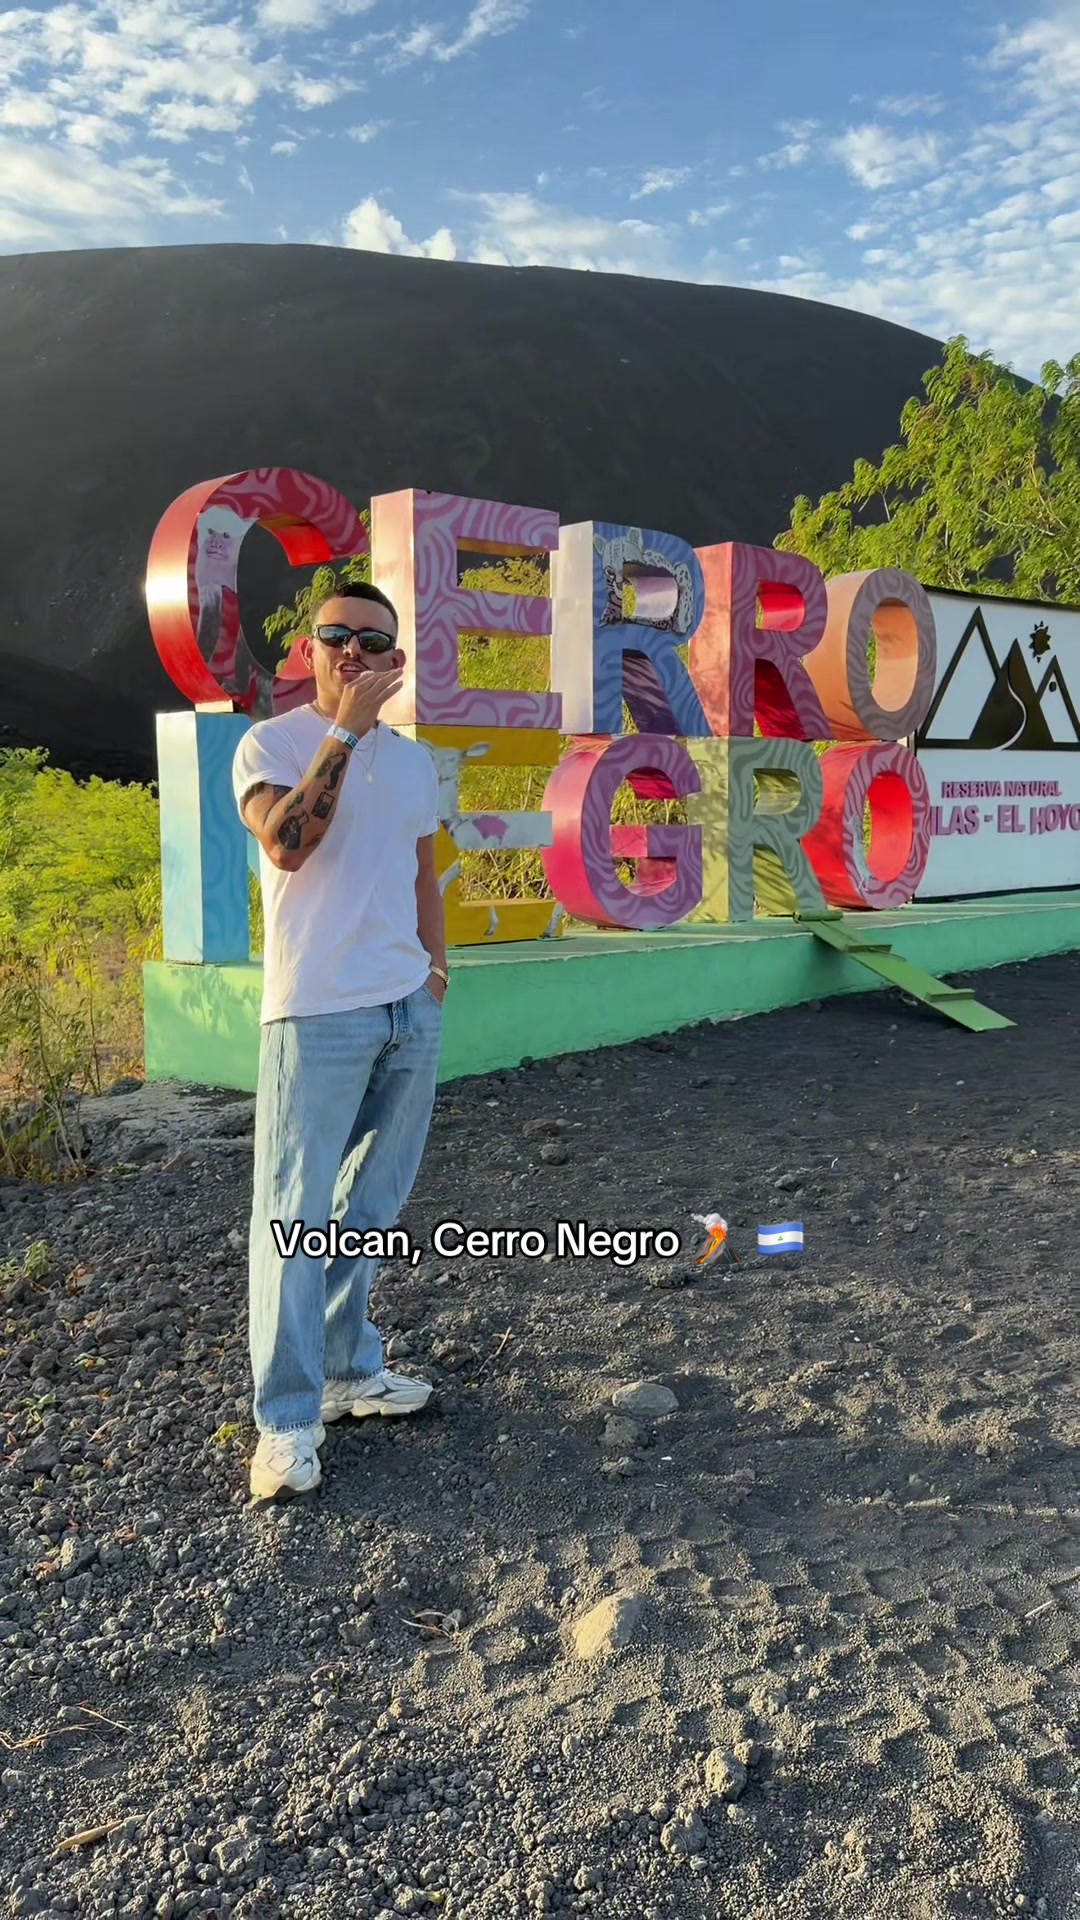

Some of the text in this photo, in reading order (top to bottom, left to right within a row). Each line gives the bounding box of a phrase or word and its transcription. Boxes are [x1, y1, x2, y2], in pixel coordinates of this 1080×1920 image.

[146, 467, 936, 742] CERRO
[941, 780, 1062, 798] RESERVA NATURAL
[997, 804, 1026, 833] EL
